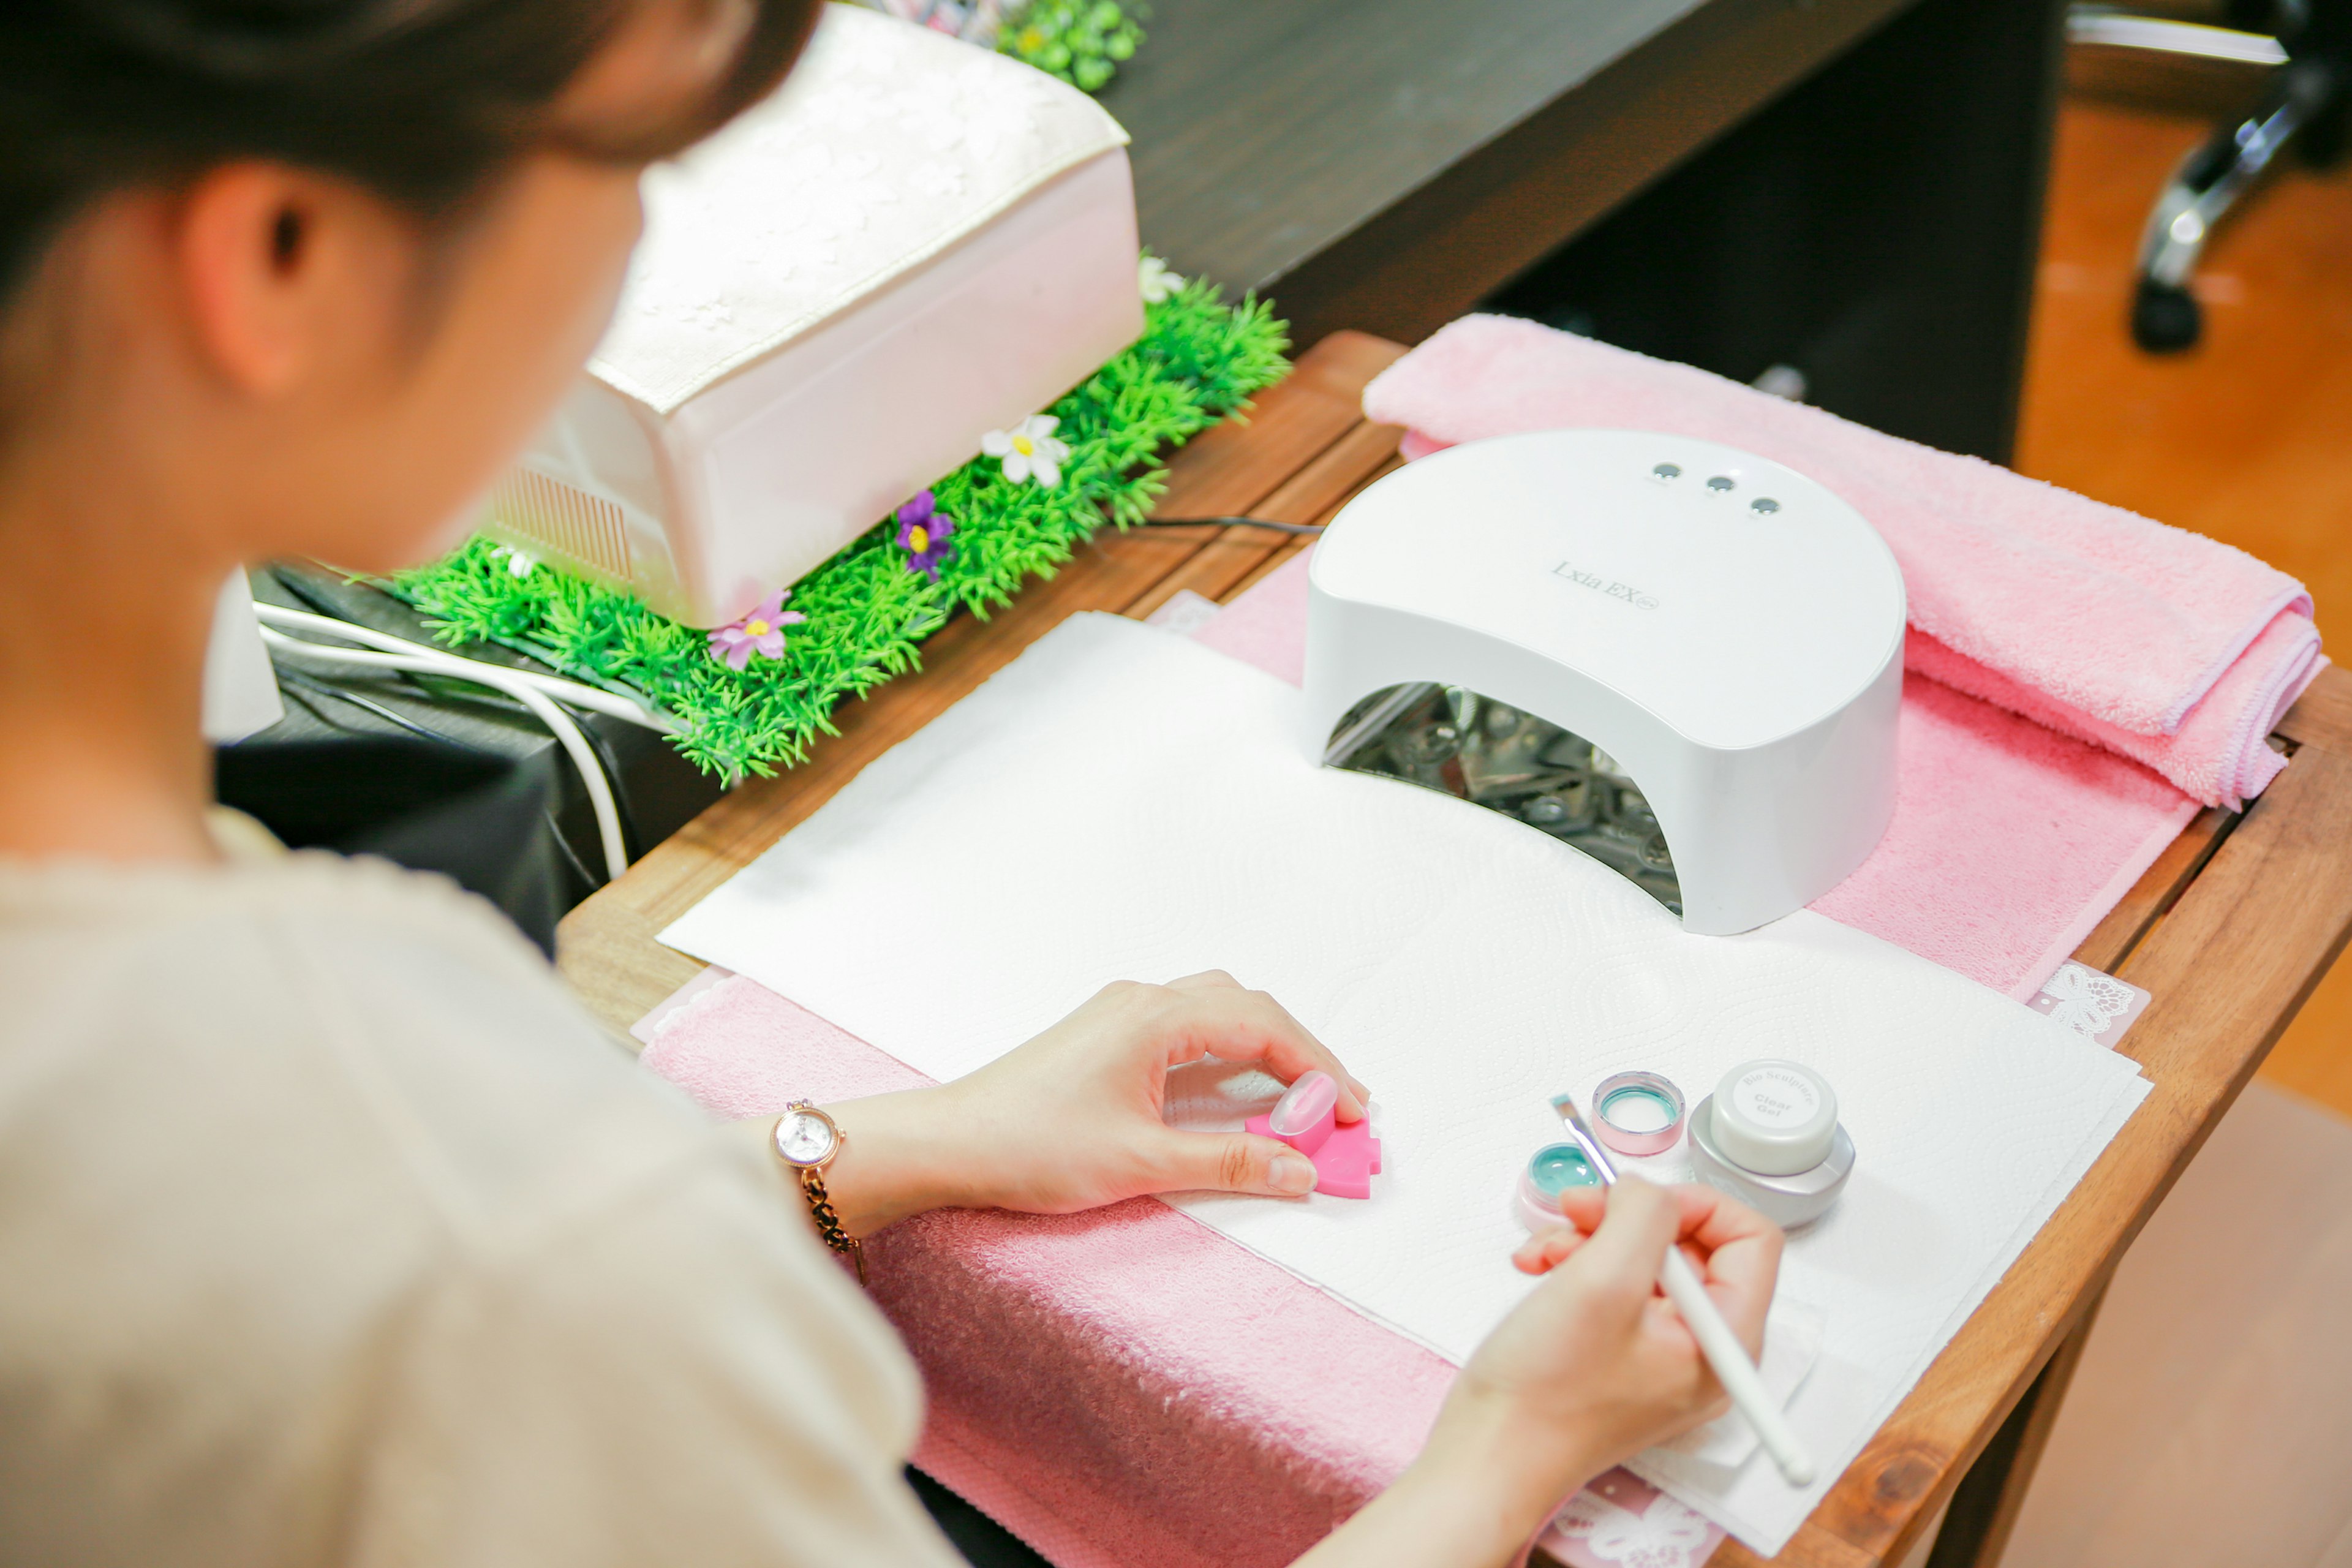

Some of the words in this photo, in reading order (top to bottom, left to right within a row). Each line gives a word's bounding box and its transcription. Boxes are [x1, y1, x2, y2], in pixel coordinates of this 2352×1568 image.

[1551, 560, 1603, 589] Lxia
[1603, 582, 1642, 603] EX
[1743, 1074, 1763, 1086] Bio
[1766, 1071, 1814, 1106] Sculpture
[1754, 1093, 1792, 1110] Clear
[1757, 1104, 1781, 1117] Gel
